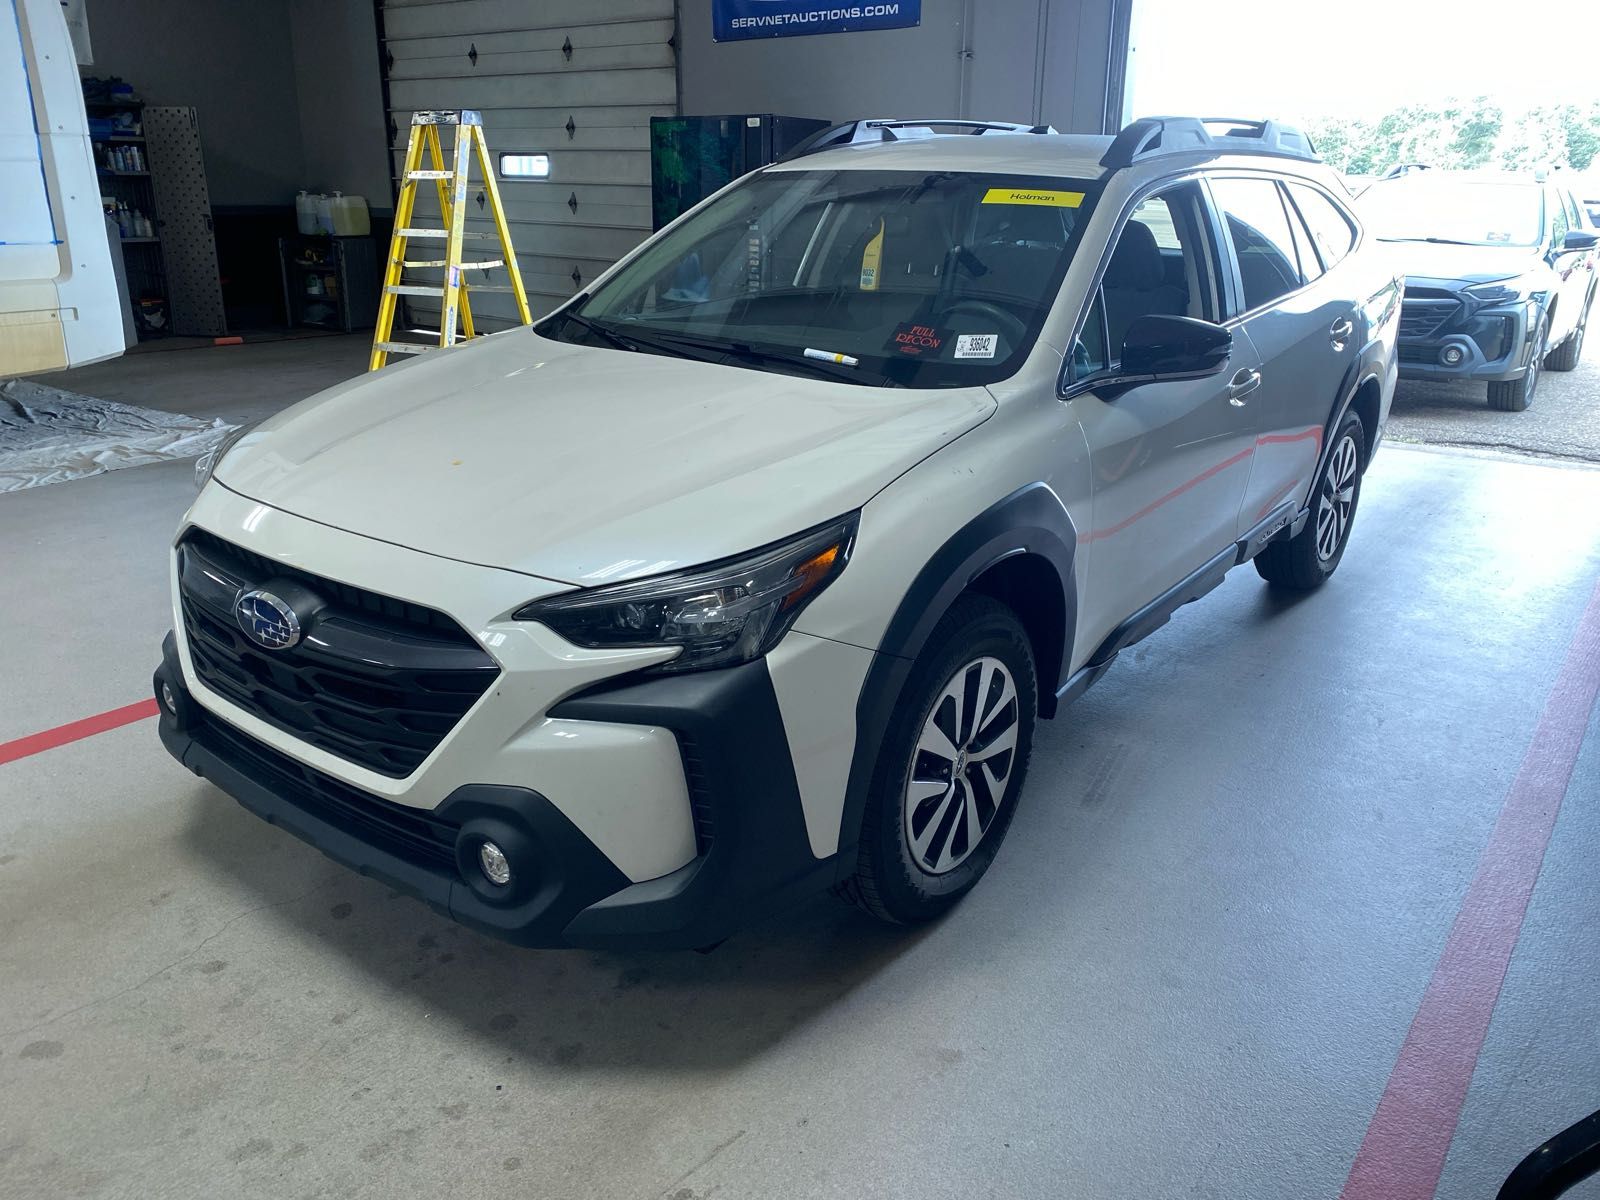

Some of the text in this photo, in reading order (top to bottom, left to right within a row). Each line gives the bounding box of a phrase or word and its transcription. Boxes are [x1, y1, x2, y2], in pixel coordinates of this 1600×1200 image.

[731, 4, 899, 28] SERVNETAUCTIONS.COM
[1010, 193, 1055, 201] Holman
[910, 325, 935, 338] FULL
[895, 333, 941, 348] RECON
